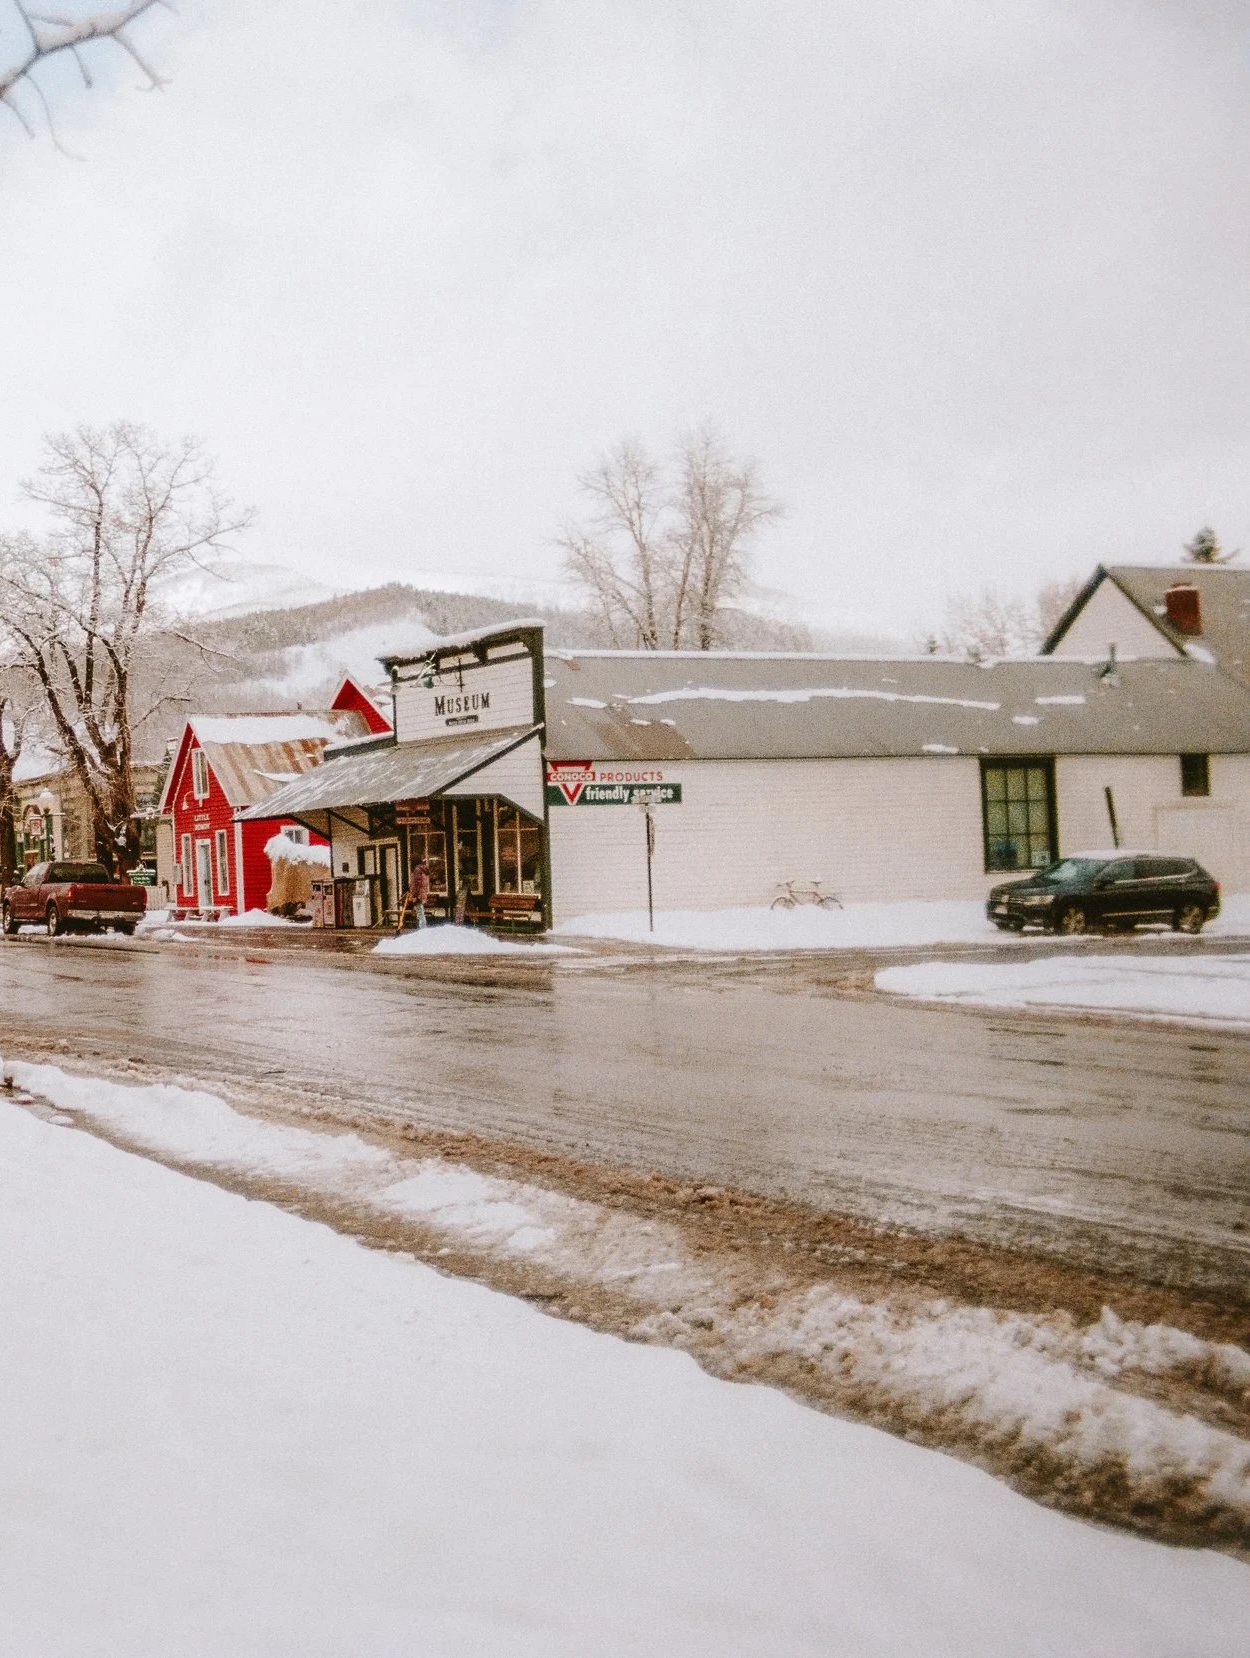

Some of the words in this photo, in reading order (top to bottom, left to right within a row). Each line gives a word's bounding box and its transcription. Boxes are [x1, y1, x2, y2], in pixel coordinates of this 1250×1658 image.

[550, 772, 593, 782] CONOCO
[600, 772, 663, 781] PRODUCTS
[585, 785, 630, 803] friendly
